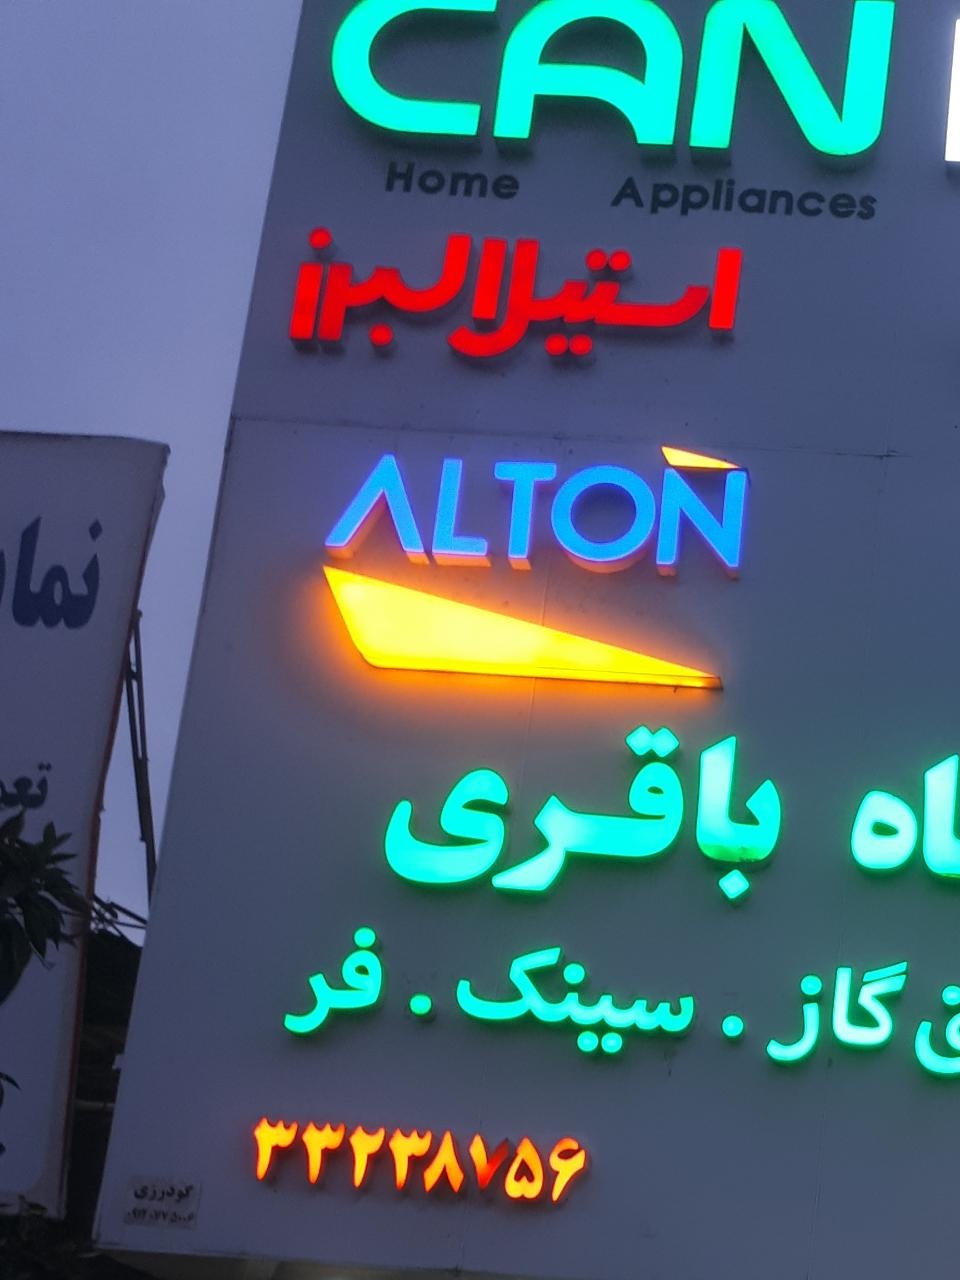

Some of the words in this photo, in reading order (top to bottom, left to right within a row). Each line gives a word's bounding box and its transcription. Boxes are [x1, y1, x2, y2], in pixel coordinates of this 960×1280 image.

[331, 0, 896, 156] CAN
[385, 162, 520, 200] Home
[611, 176, 878, 220] Appliances
[325, 446, 750, 571] ALTON
[384, 725, 783, 900] باقری
[284, 926, 384, 1034] فر
[456, 946, 695, 1053] سینک
[766, 961, 909, 1063] گاز
